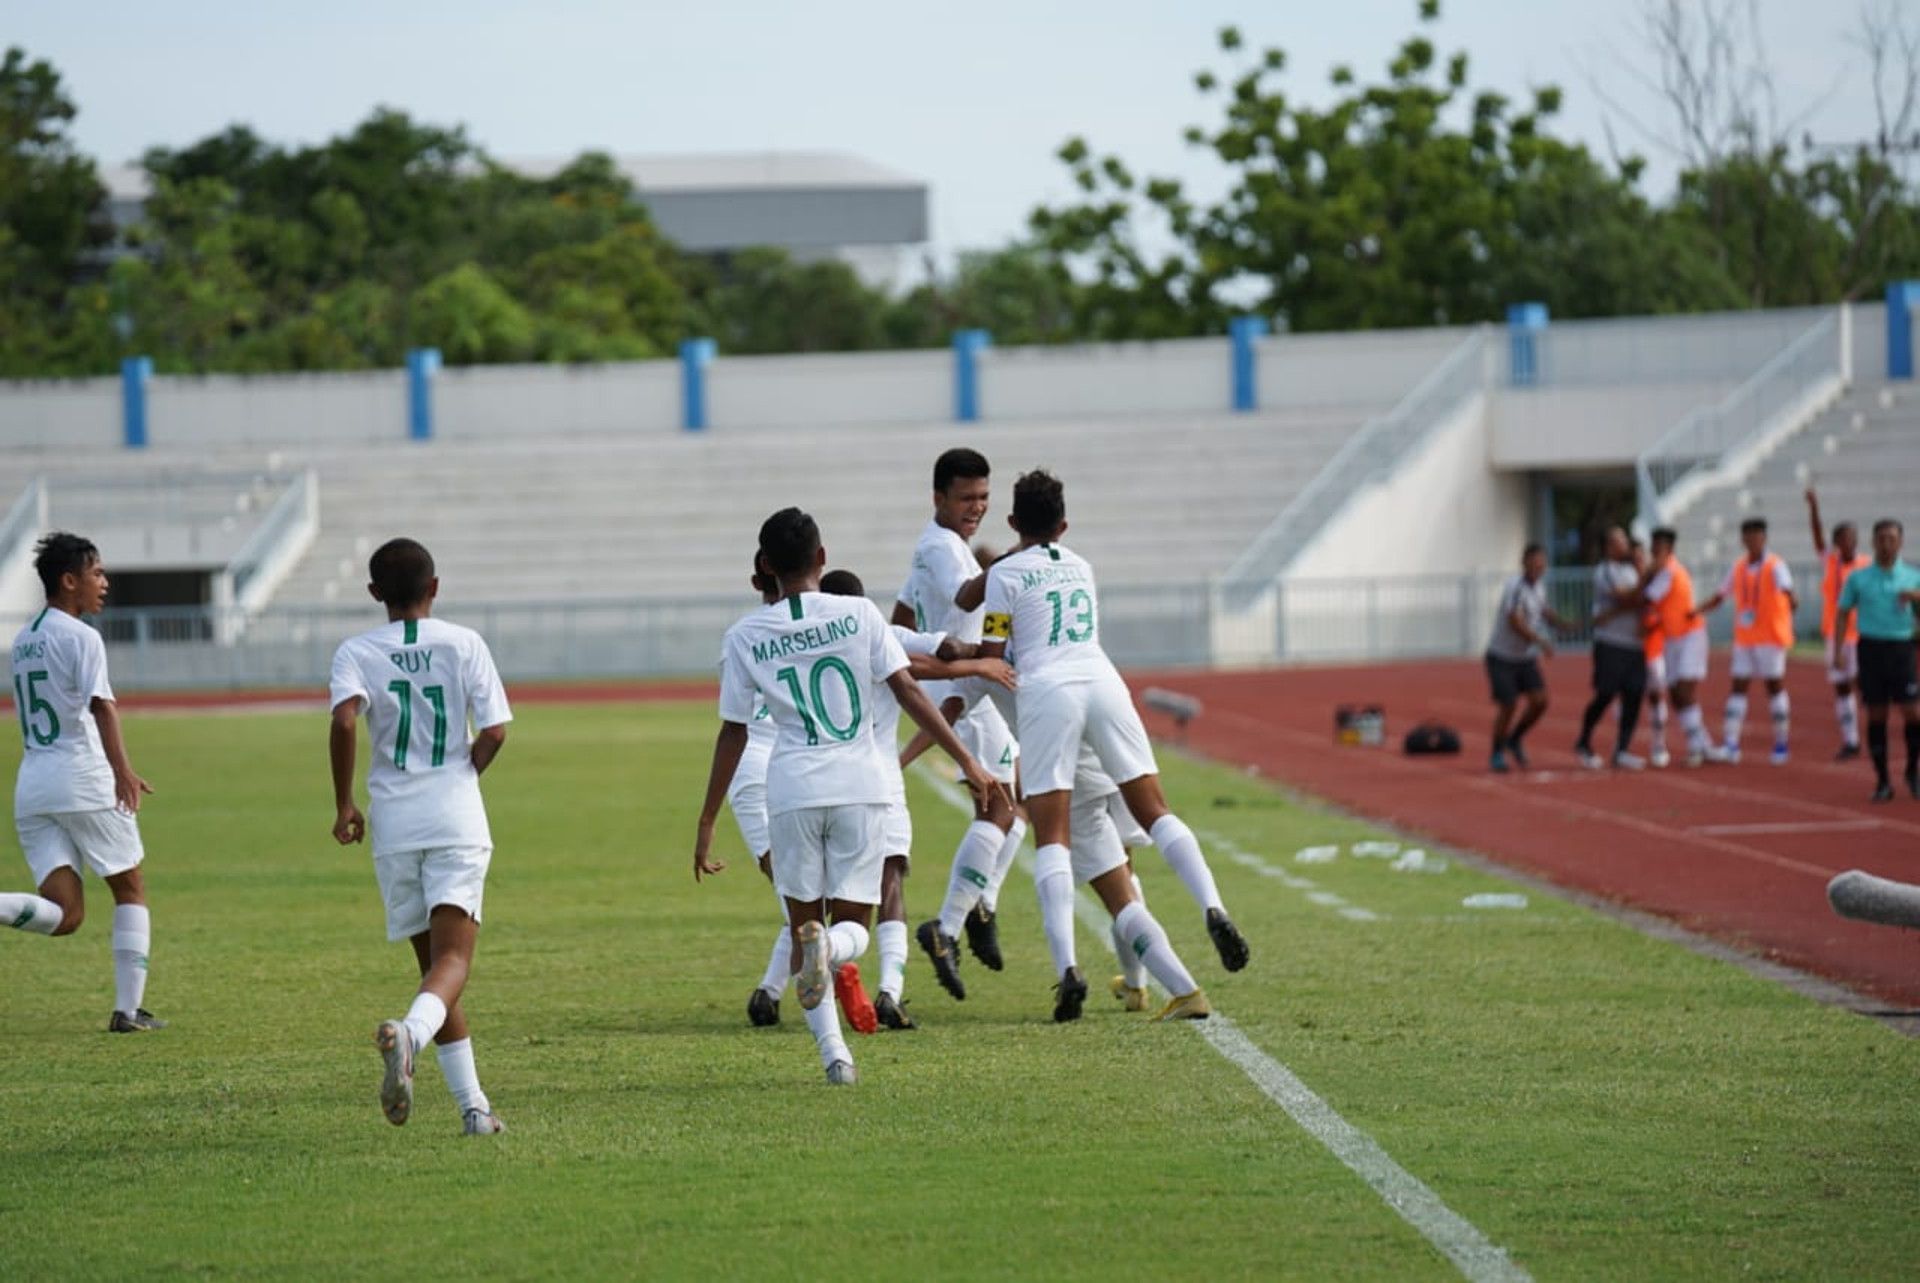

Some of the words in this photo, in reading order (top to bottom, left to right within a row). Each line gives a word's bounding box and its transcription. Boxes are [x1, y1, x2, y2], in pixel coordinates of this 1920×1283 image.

[752, 616, 859, 664] MARSELINO
[983, 615, 995, 634] C
[1046, 589, 1094, 646] 13
[390, 649, 432, 673] RUY
[15, 670, 60, 749] 15
[388, 680, 446, 770] 11
[777, 656, 861, 746] 10
[999, 743, 1013, 768] 4
